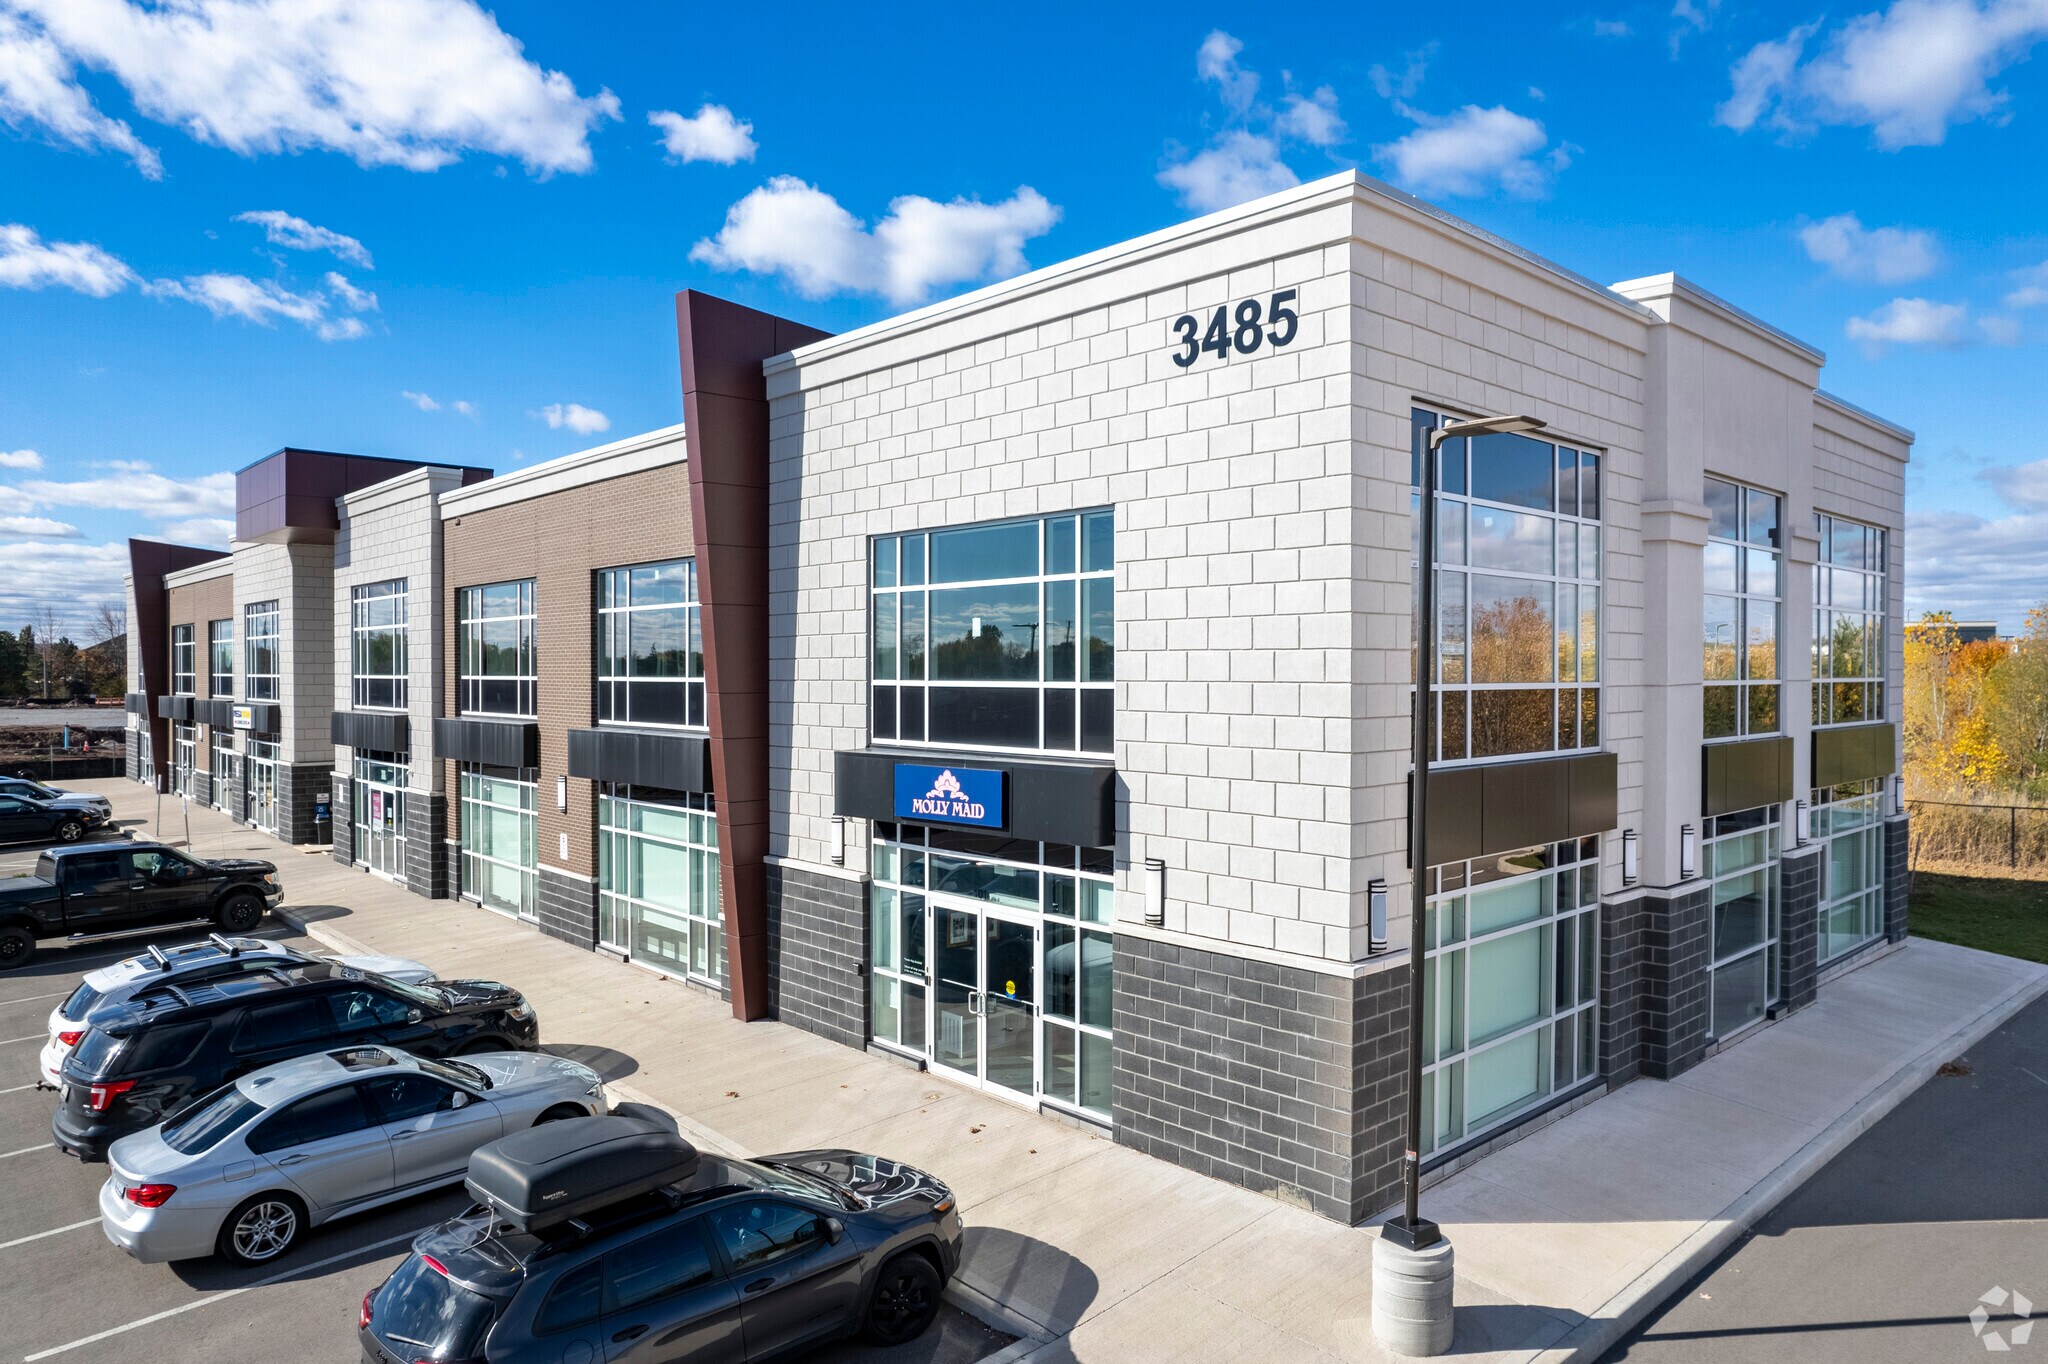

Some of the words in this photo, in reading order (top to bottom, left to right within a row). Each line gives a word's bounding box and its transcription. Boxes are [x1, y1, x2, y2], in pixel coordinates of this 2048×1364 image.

[1172, 288, 1298, 368] 3485
[912, 798, 950, 816] MOLLY
[952, 801, 985, 819] MAID
